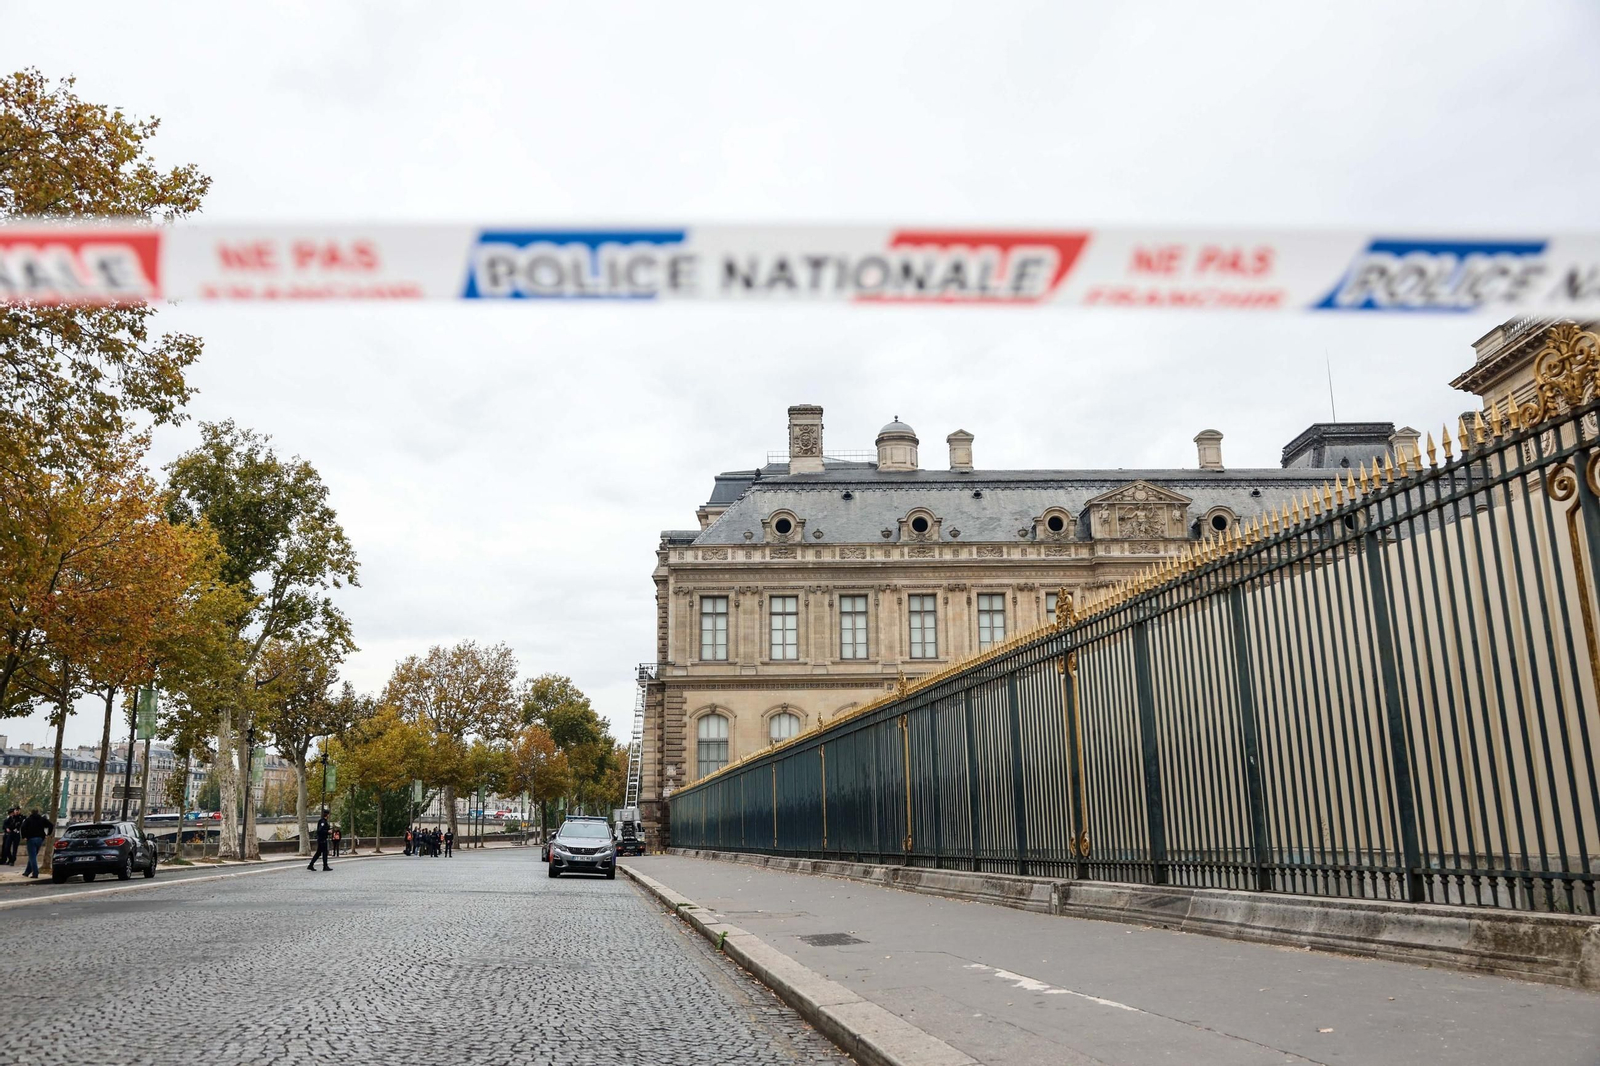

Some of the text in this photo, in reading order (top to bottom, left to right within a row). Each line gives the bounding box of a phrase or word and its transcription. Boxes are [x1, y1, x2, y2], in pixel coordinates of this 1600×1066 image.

[217, 240, 380, 271] NE PAS
[486, 253, 1048, 292] POLICE NATIONALE
[1129, 245, 1276, 276] NE PAS
[1348, 262, 1600, 302] POLICE N
